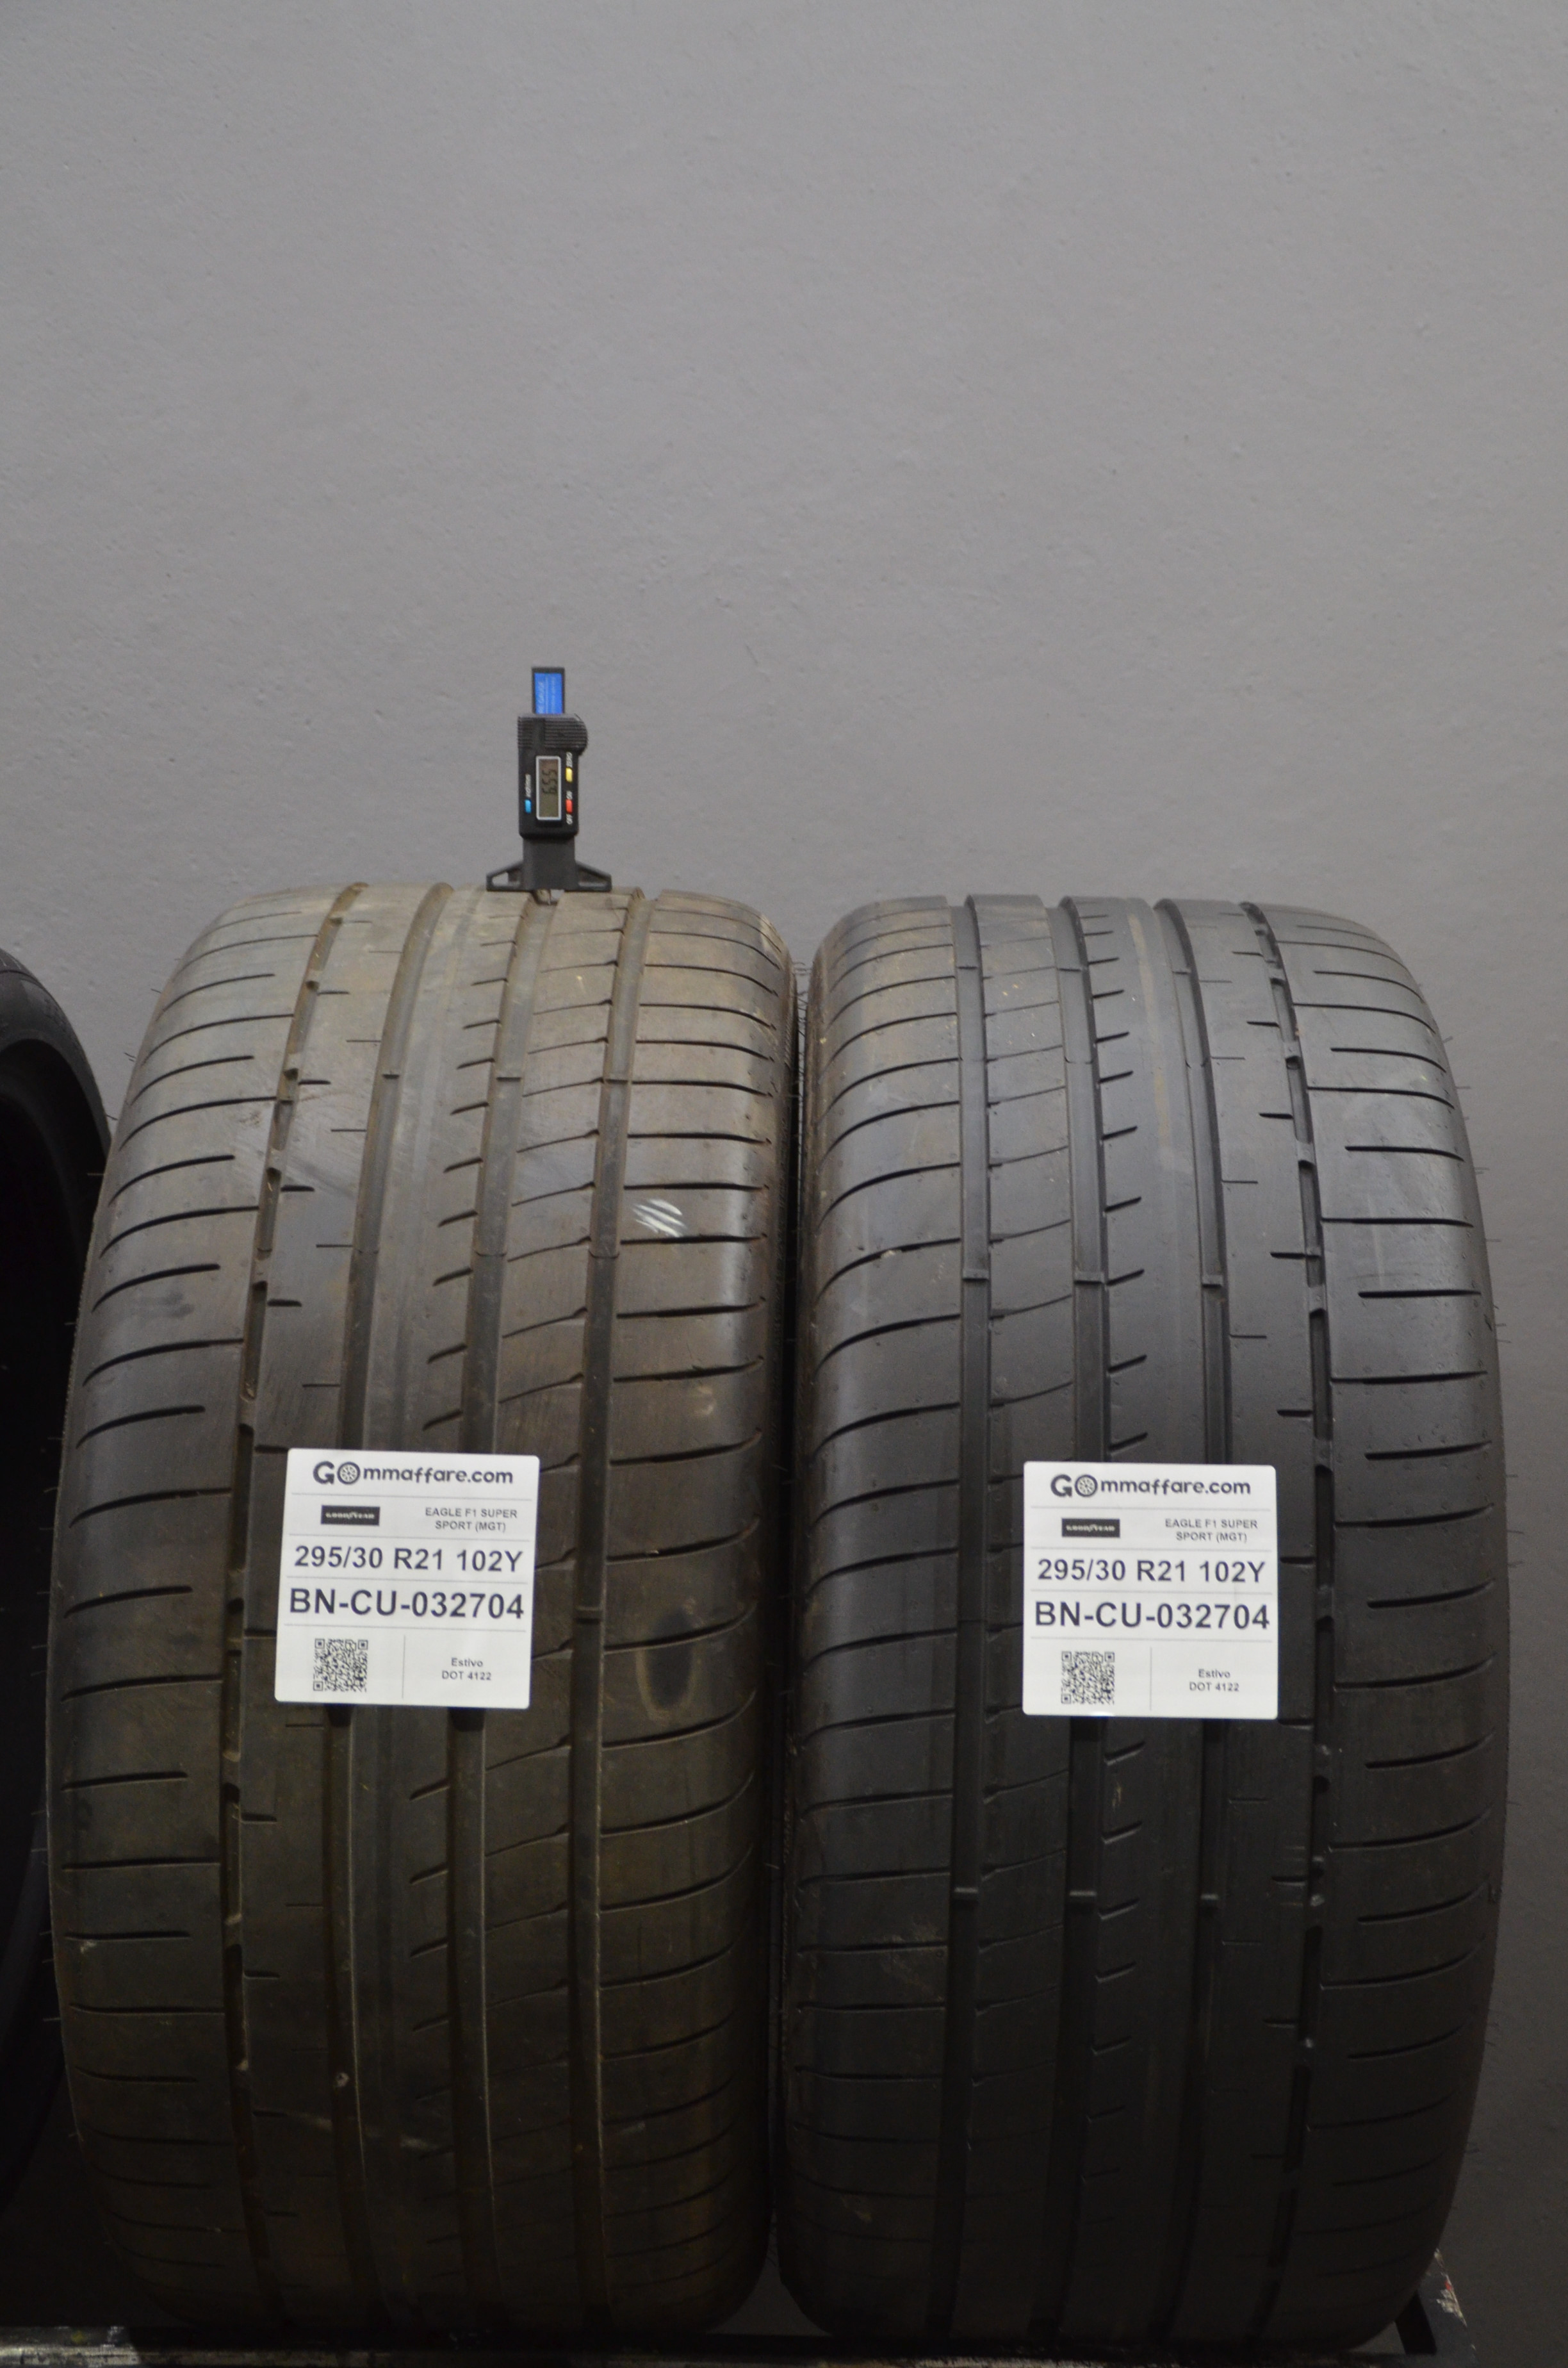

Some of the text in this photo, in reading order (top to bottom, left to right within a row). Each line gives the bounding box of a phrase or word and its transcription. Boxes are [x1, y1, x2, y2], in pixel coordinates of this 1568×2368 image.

[425, 1508, 517, 1518] EAGLE F1 SUPER
[436, 1520, 505, 1532] SPORT (MGT)
[1166, 1519, 1257, 1528] EAGLE F1 SUPER
[1177, 1531, 1246, 1543] SPORT (MGT)
[295, 1545, 522, 1572] 295/30 R21 102Y
[1038, 1559, 1264, 1583] 295/30 R21 102Y
[290, 1588, 523, 1618] BN-CU-032704
[1036, 1602, 1269, 1629] BN-CU-032704
[452, 1657, 483, 1667] Estivo
[442, 1670, 491, 1681] DOT 4122
[1198, 1669, 1230, 1678] Estivo
[1189, 1682, 1239, 1691] DOT 4122
